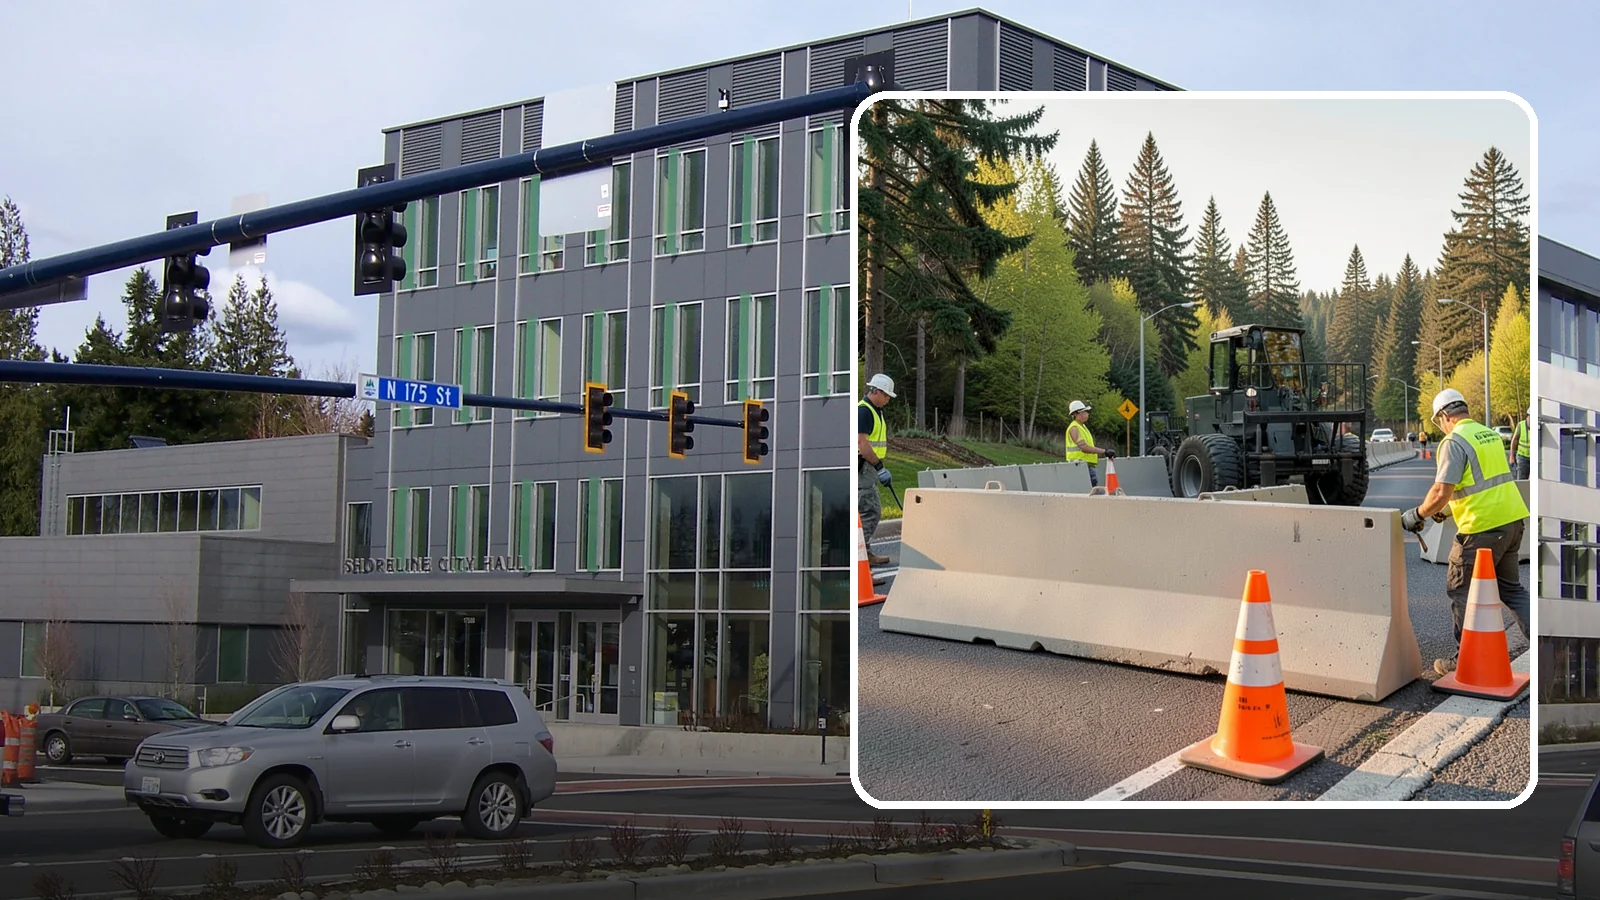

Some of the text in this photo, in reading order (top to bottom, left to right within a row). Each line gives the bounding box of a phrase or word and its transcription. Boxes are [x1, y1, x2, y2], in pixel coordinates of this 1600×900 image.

[387, 380, 451, 406] N 175 St
[344, 556, 525, 574] SHORELINE CITY HALL
